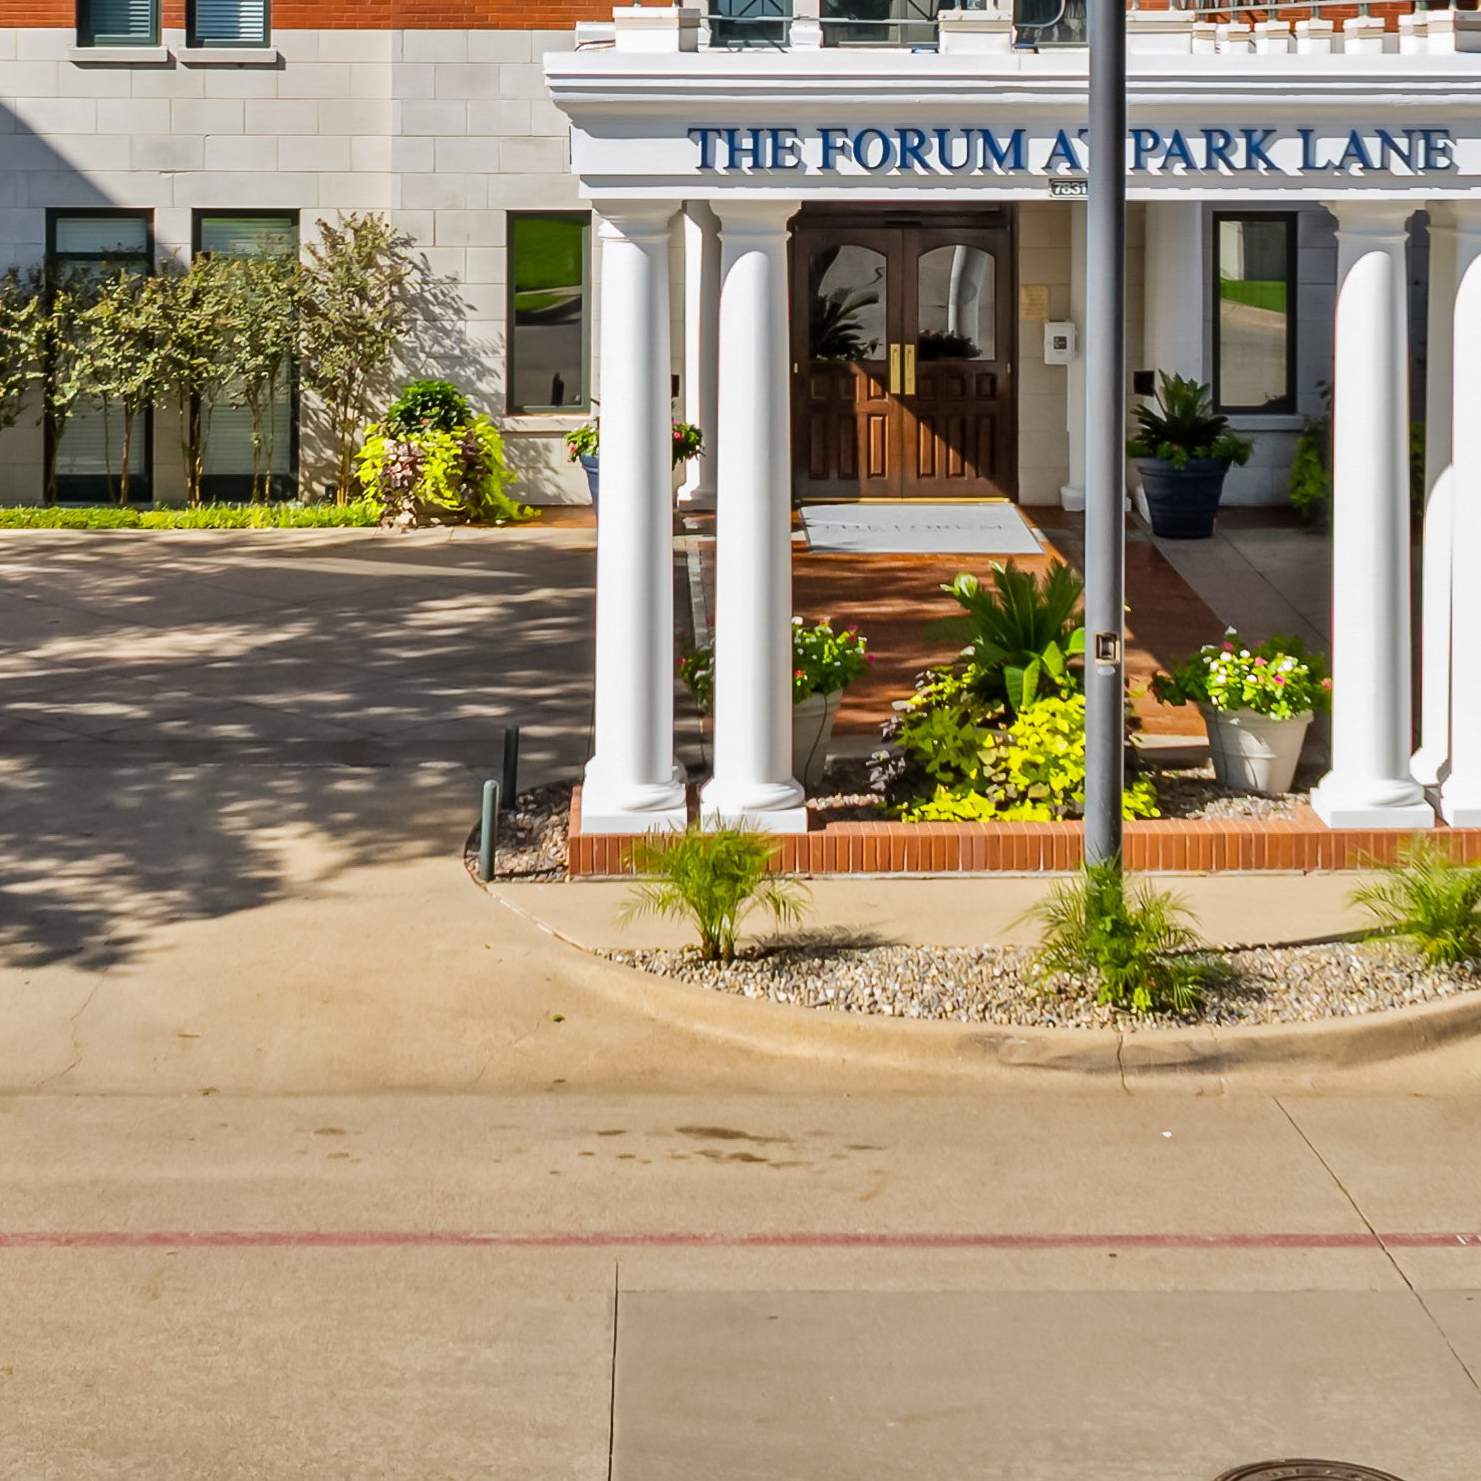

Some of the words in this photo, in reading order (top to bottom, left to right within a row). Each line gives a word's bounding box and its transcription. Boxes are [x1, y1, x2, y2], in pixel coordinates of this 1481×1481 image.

[687, 127, 802, 170] THE
[816, 127, 1027, 170] FORUM
[1039, 128, 1089, 170] A
[1128, 128, 1282, 170] PARK
[1297, 128, 1454, 170] LANE
[1053, 182, 1087, 195] 7831
